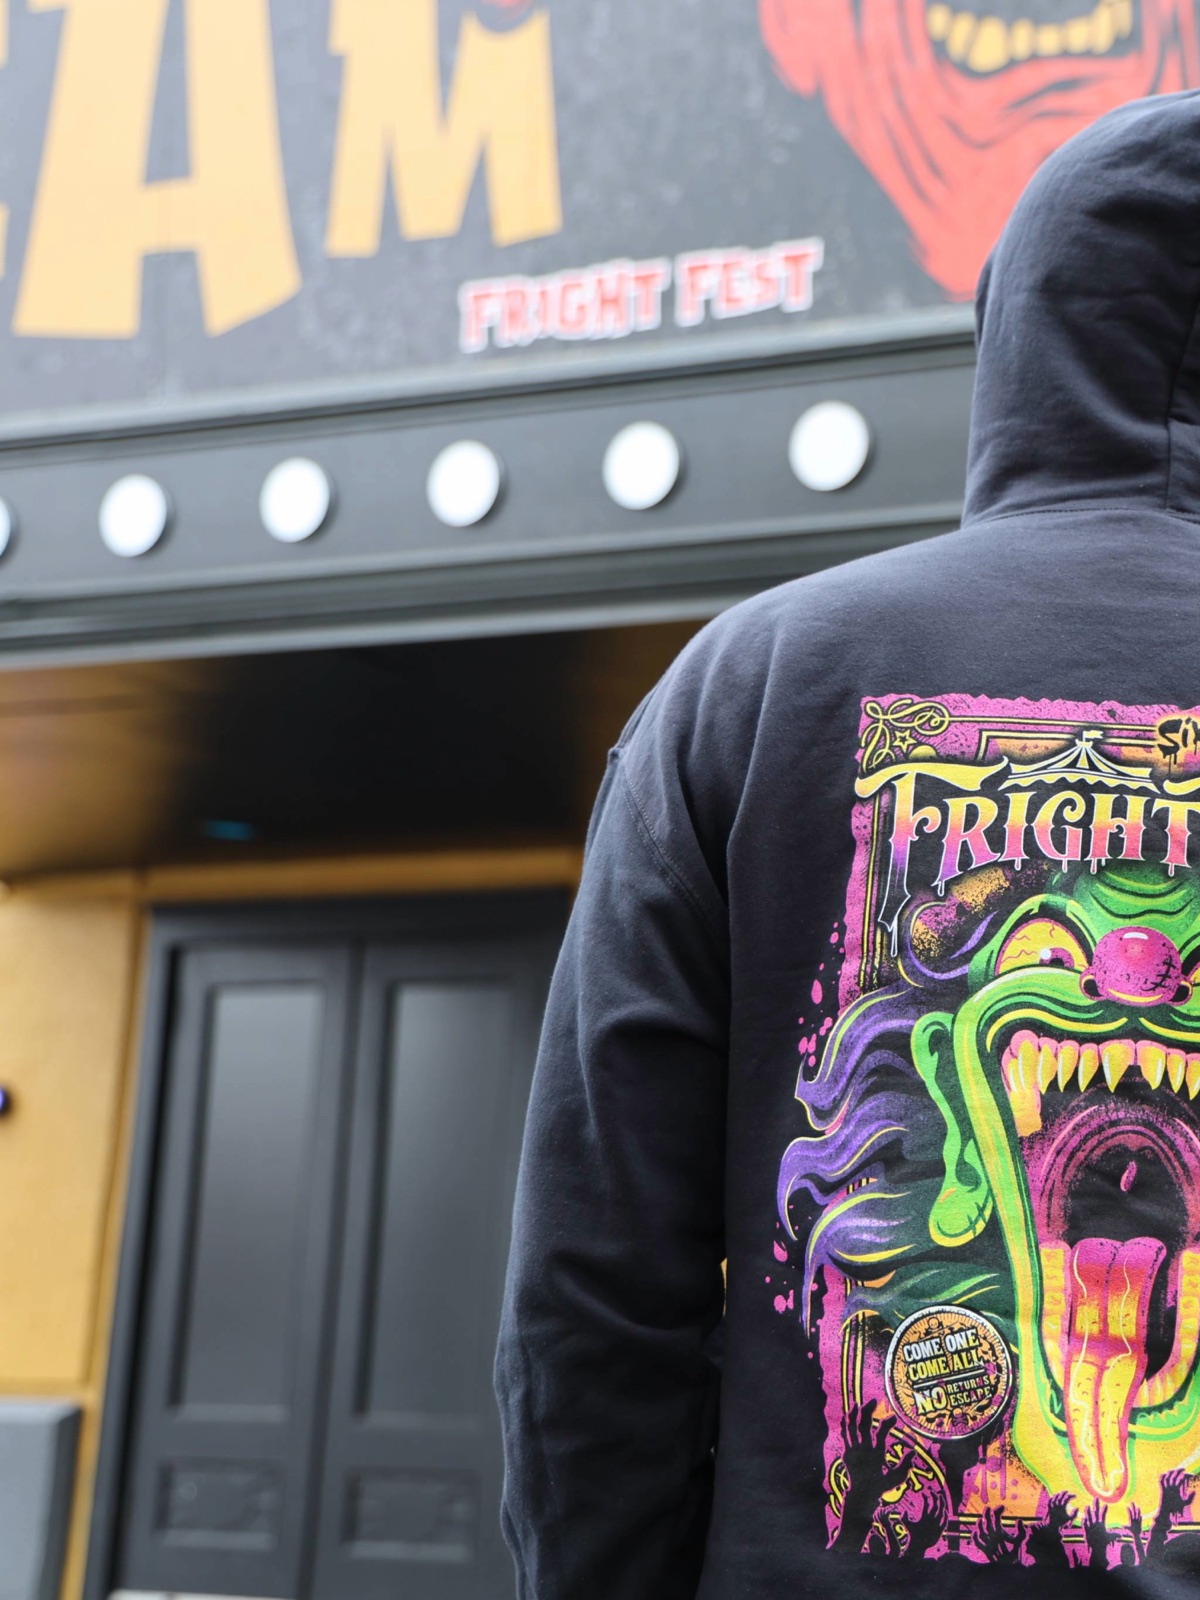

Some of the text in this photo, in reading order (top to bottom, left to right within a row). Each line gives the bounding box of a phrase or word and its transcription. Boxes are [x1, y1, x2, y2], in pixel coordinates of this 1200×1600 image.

[0, 0, 563, 340] AM
[459, 236, 824, 353] FRIGHT FEST
[903, 1328, 980, 1362] COME ONE
[908, 1349, 985, 1381] COME ALL
[947, 1374, 990, 1393] RETURNS
[949, 1386, 993, 1406] ESCAPE
[913, 1386, 948, 1415] NO
